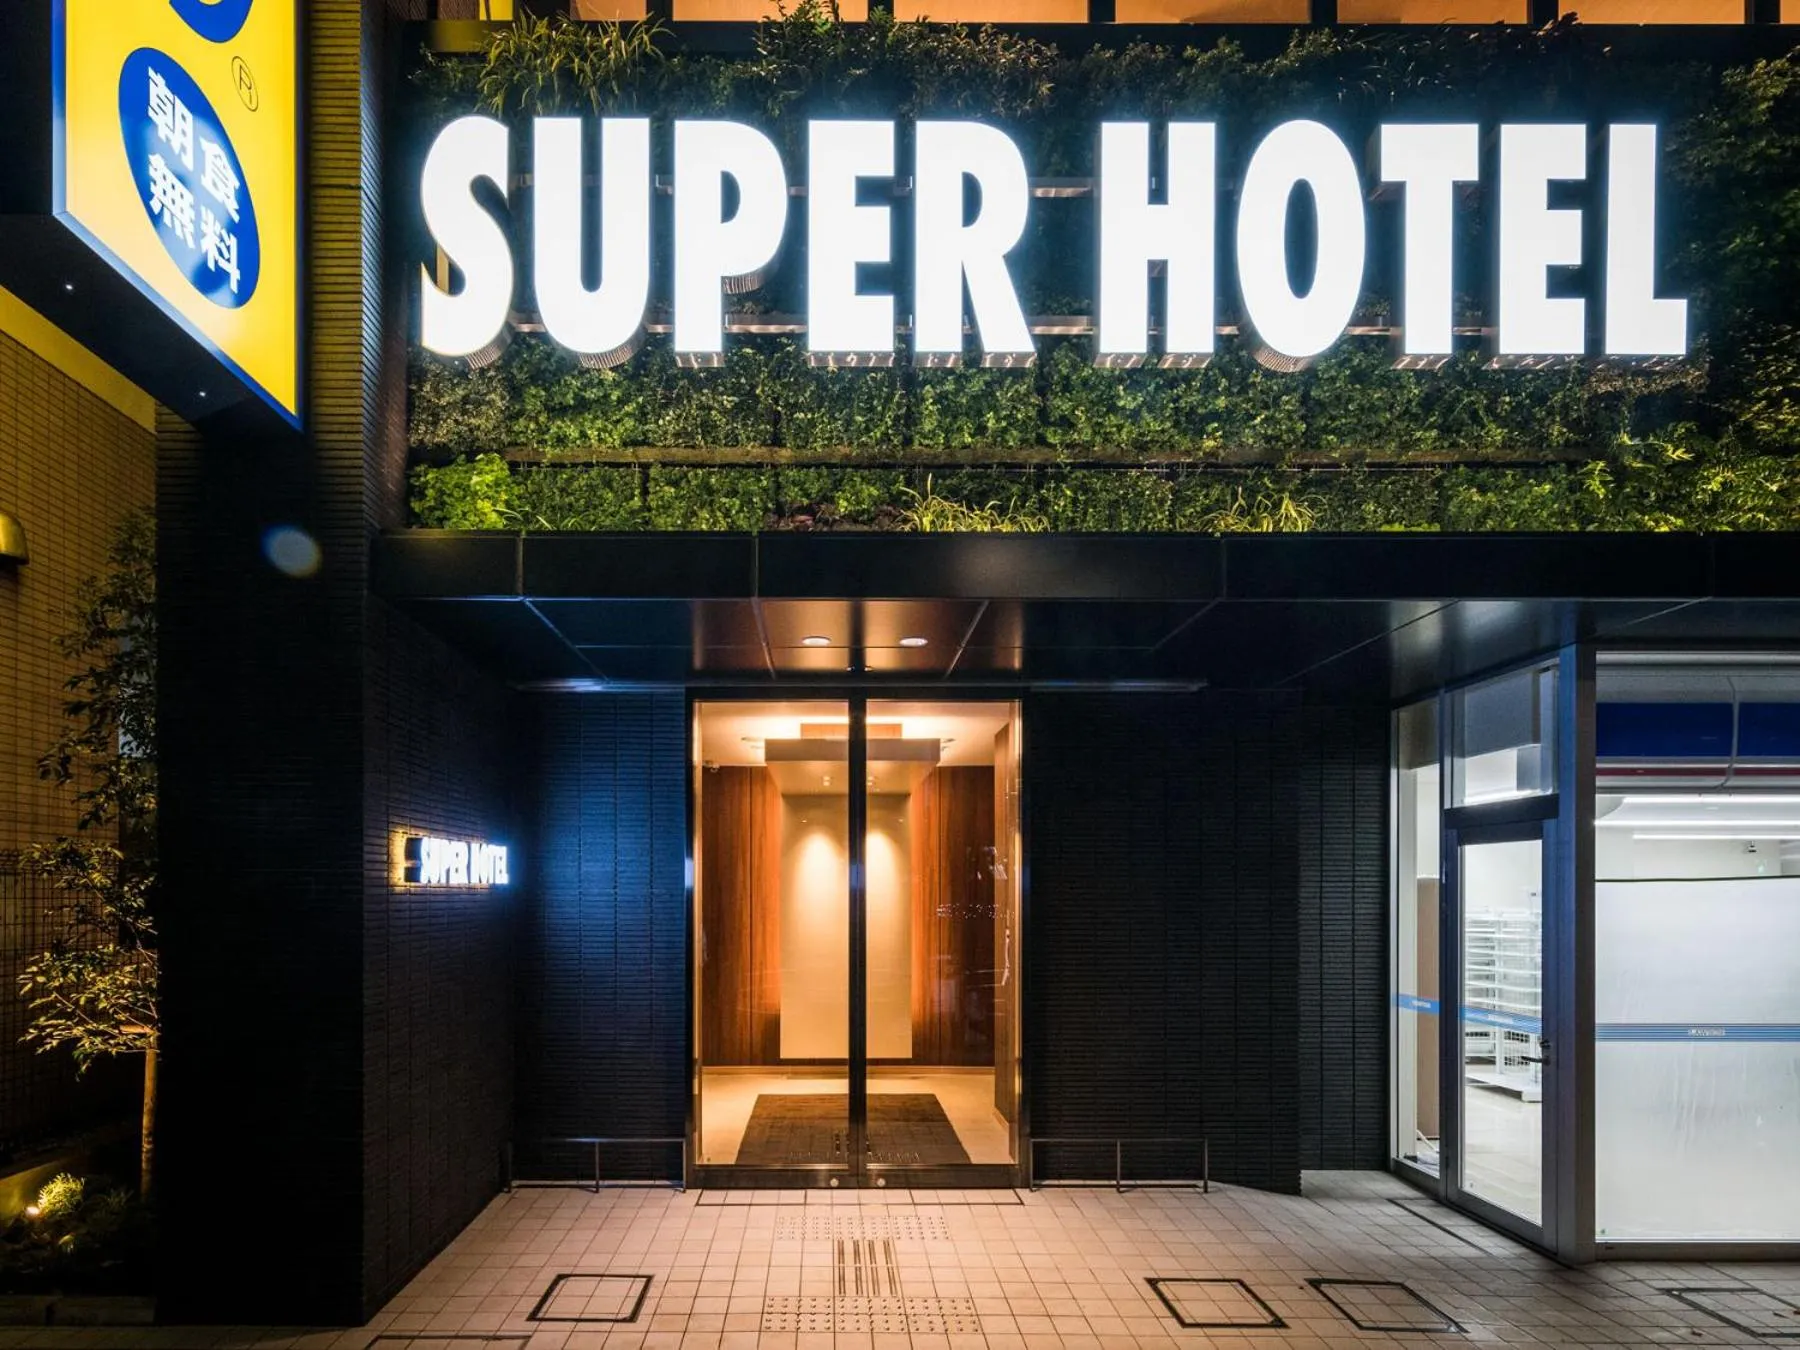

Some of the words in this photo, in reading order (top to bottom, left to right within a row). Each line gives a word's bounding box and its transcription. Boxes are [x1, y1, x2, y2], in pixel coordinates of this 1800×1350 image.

[147, 66, 240, 223] 朝食
[148, 154, 241, 294] 無料
[421, 115, 1036, 357] SUPER
[1099, 119, 1688, 358] HOTEL
